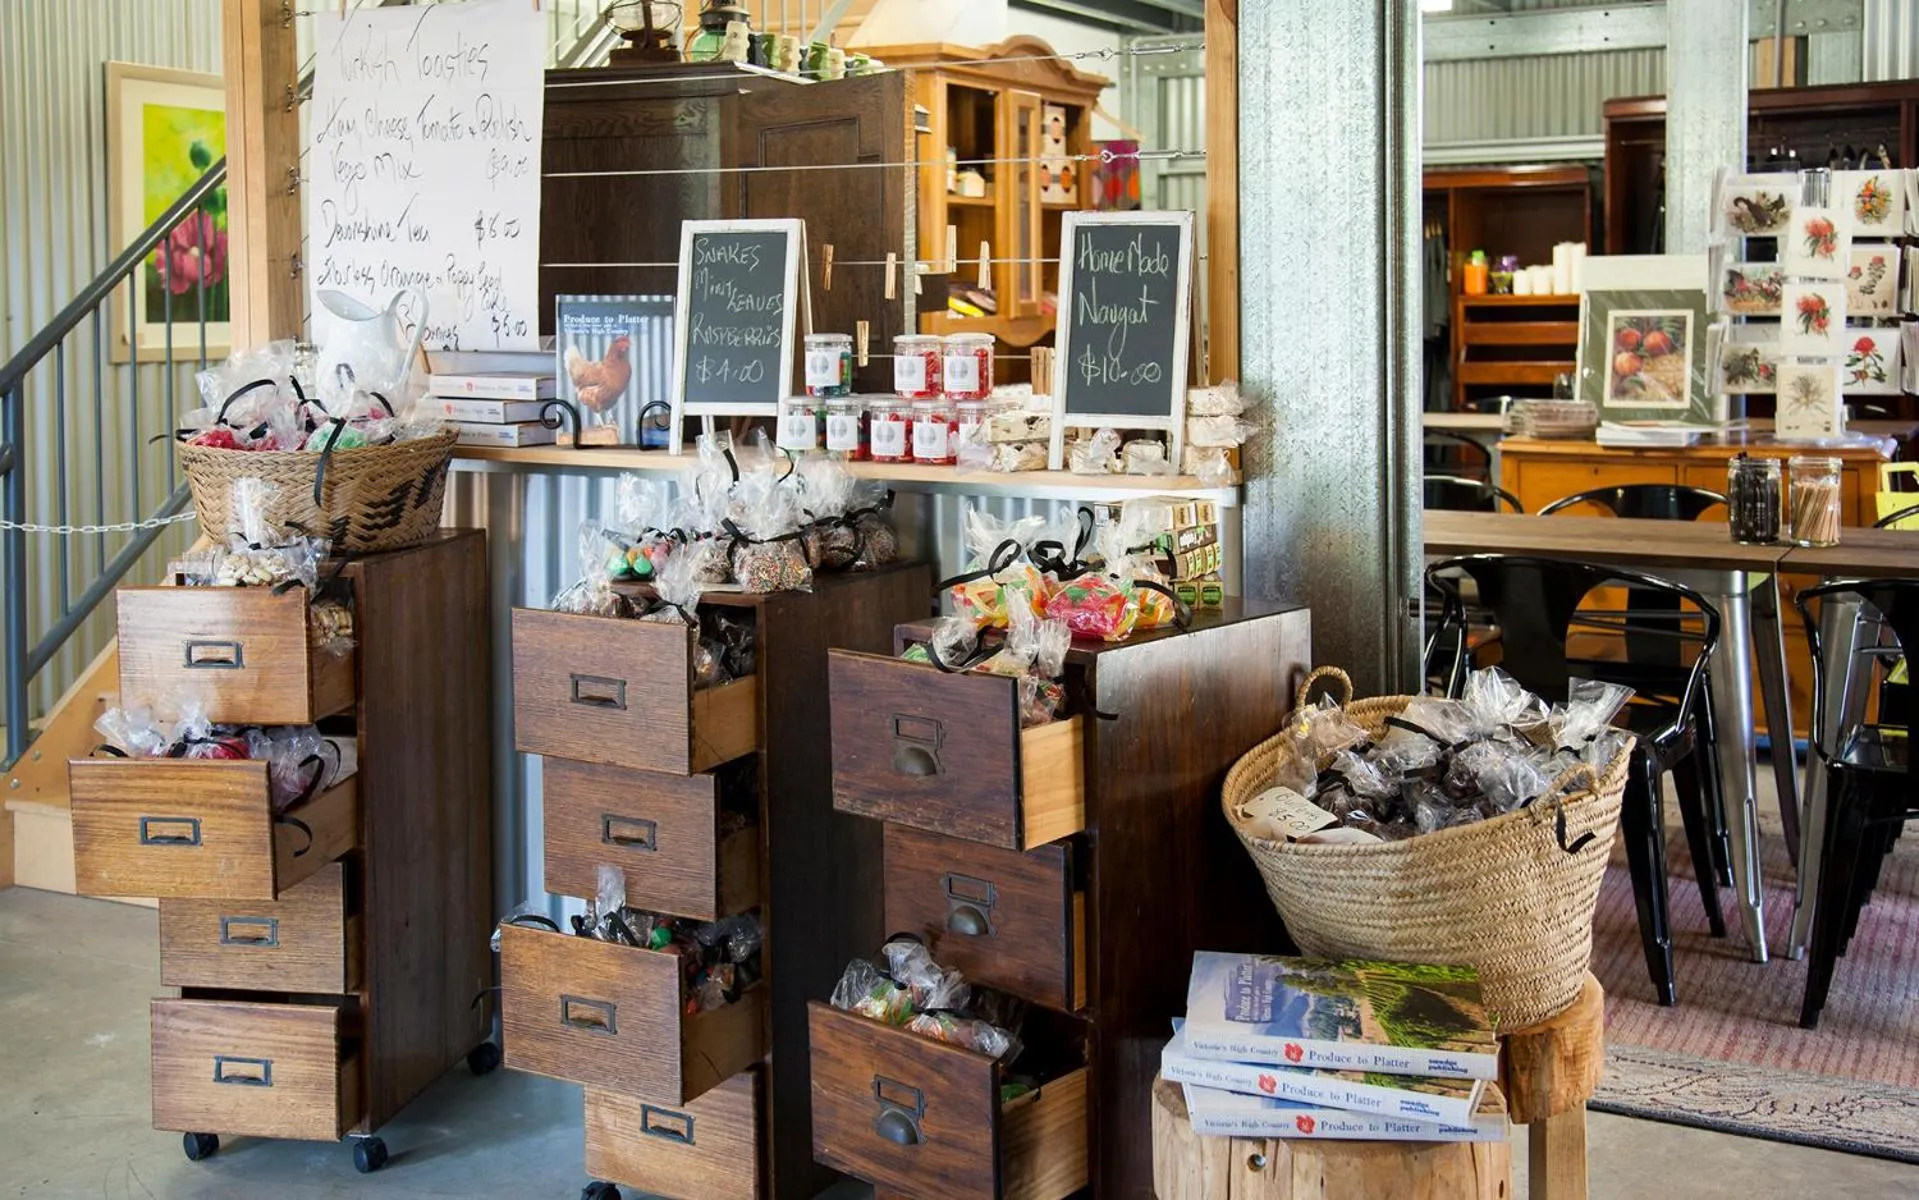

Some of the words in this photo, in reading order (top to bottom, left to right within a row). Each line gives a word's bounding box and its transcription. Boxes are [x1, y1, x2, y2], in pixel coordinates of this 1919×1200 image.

[407, 4, 489, 82] Toasties
[696, 237, 761, 272] SNAKES
[604, 315, 614, 324] to
[1078, 343, 1162, 386] $10.00
[1308, 1050, 1351, 1063] Produce
[1357, 1055, 1368, 1064] to
[1374, 1056, 1410, 1069] Platter
[1282, 1083, 1324, 1098] Produce
[1330, 1091, 1340, 1101] to
[1346, 1092, 1382, 1107] Platter
[1321, 1120, 1363, 1133] Produce
[1369, 1122, 1379, 1132] to
[1385, 1121, 1421, 1133] Platter
